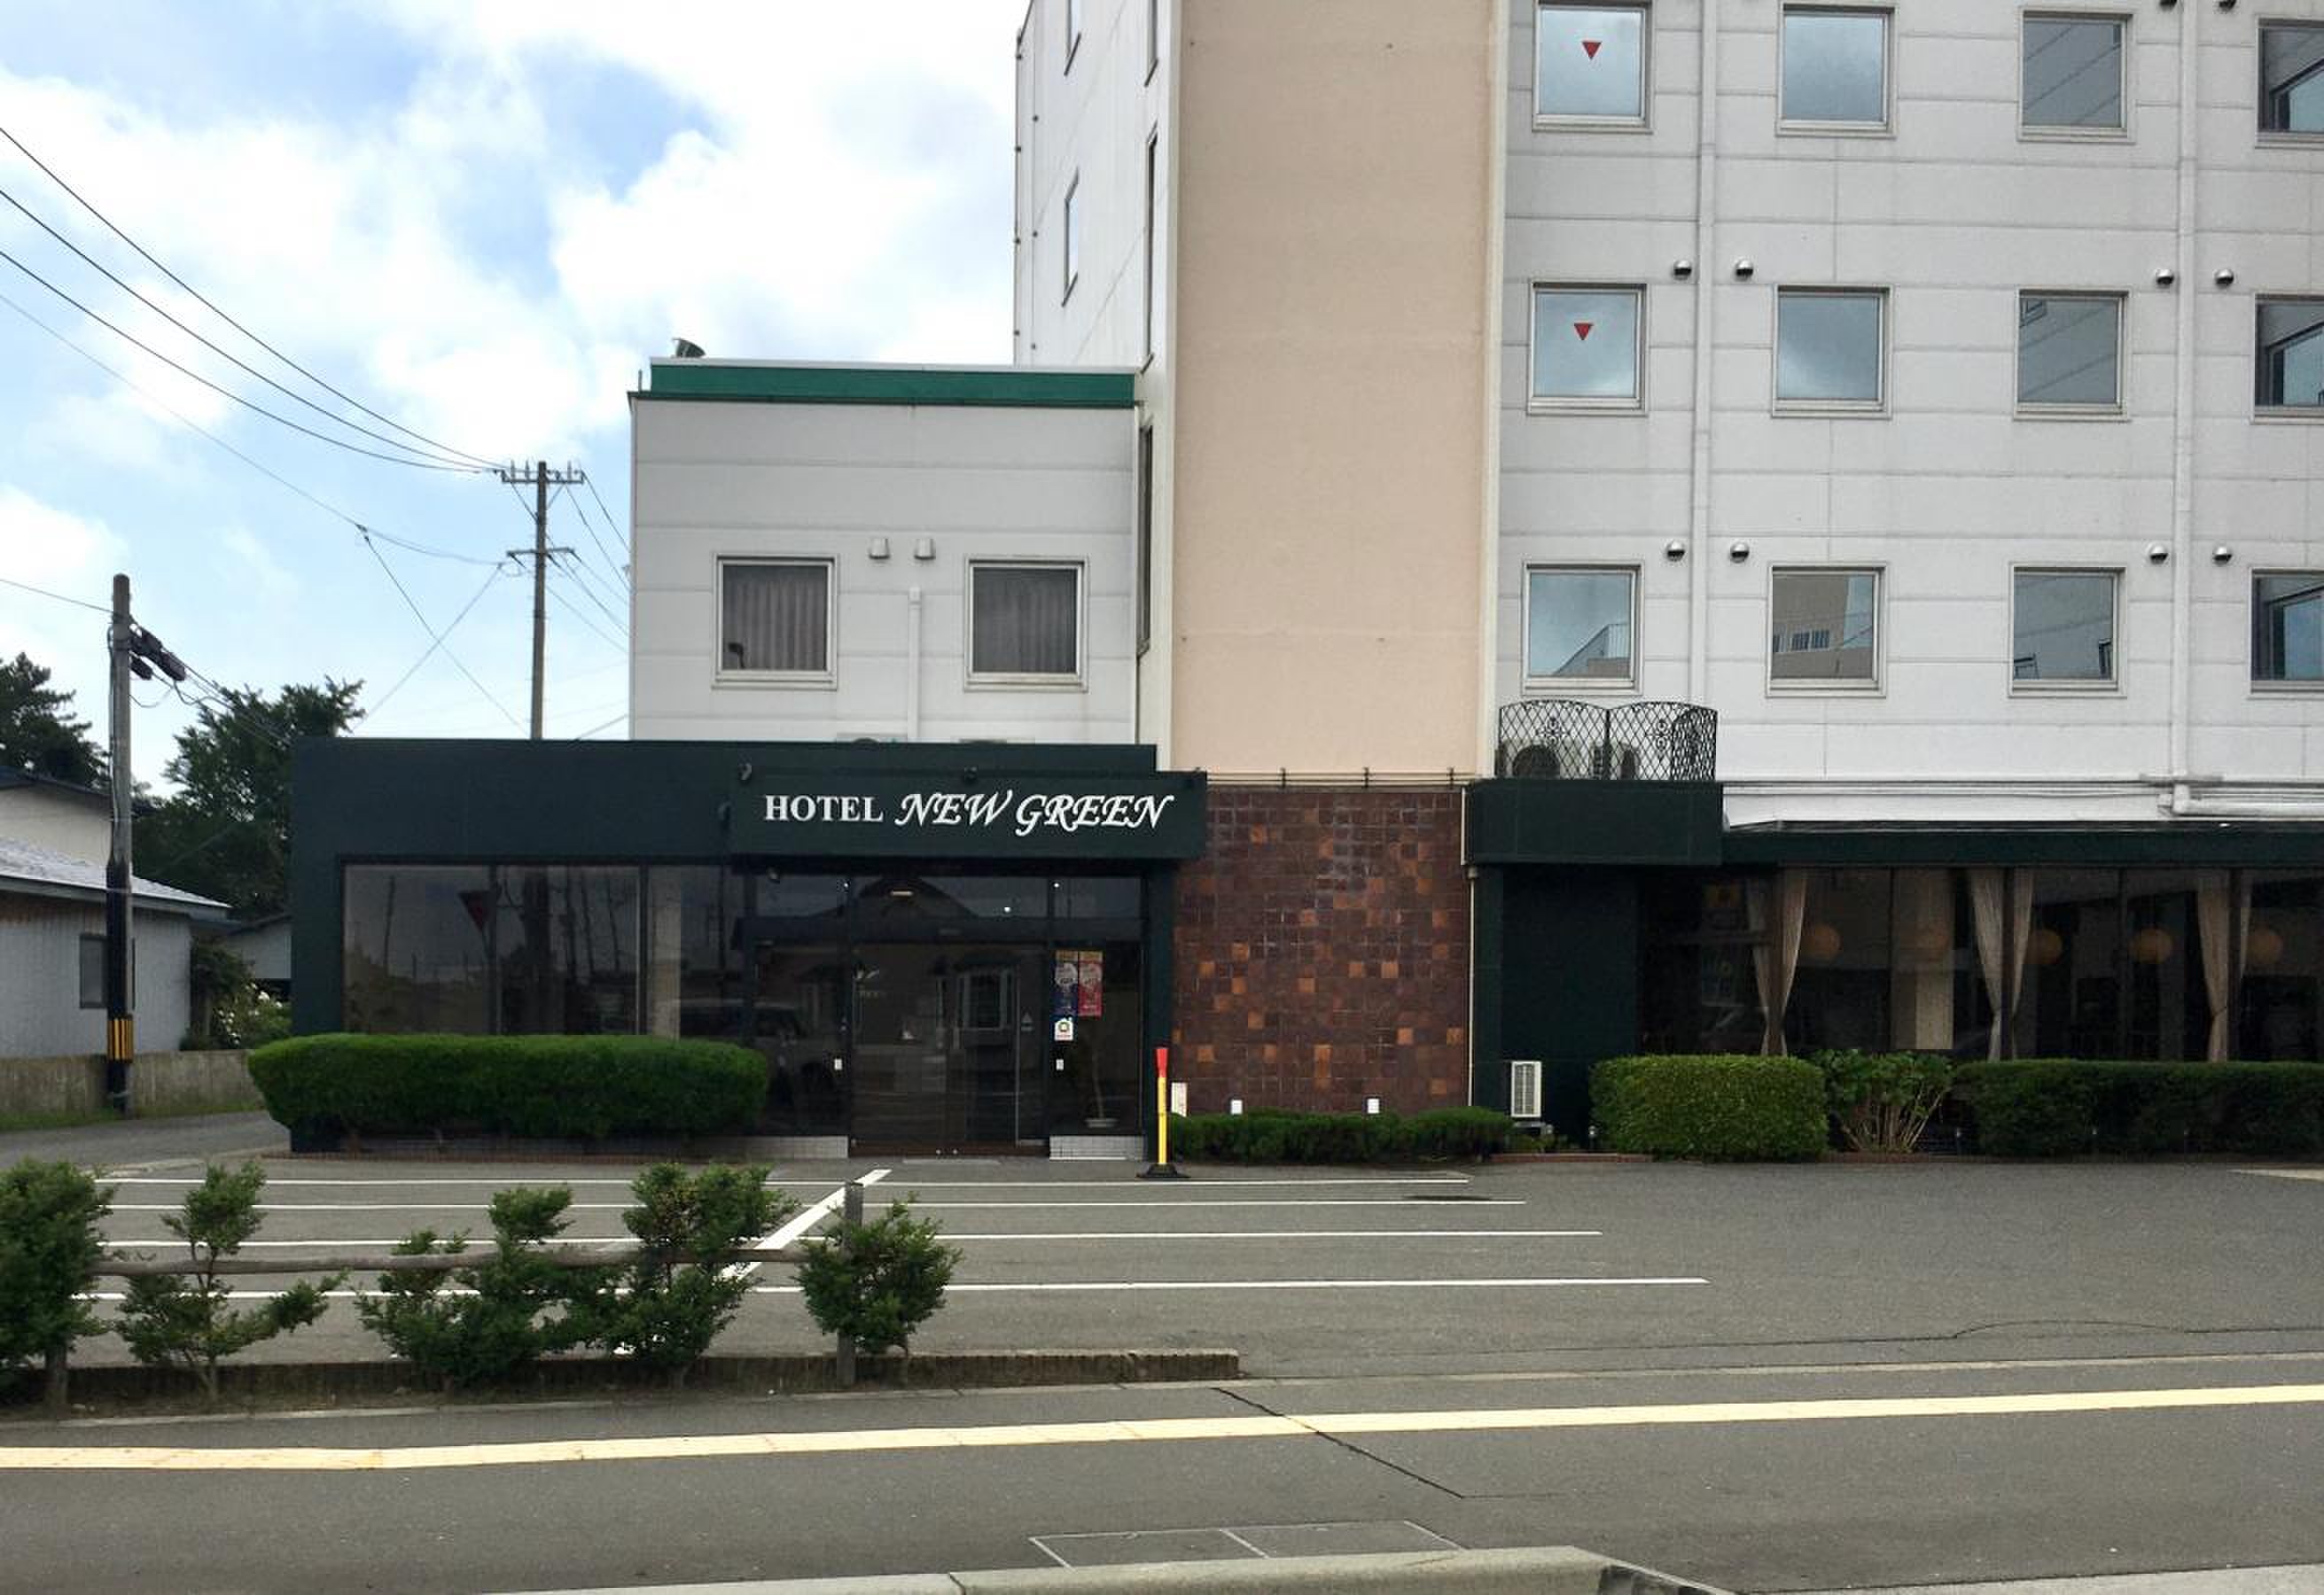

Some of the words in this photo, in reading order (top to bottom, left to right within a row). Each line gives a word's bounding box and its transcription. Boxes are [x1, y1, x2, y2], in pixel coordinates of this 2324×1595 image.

[764, 795, 884, 822] HOTEL
[893, 790, 1014, 827] NEW
[1015, 794, 1175, 836] GREEN
